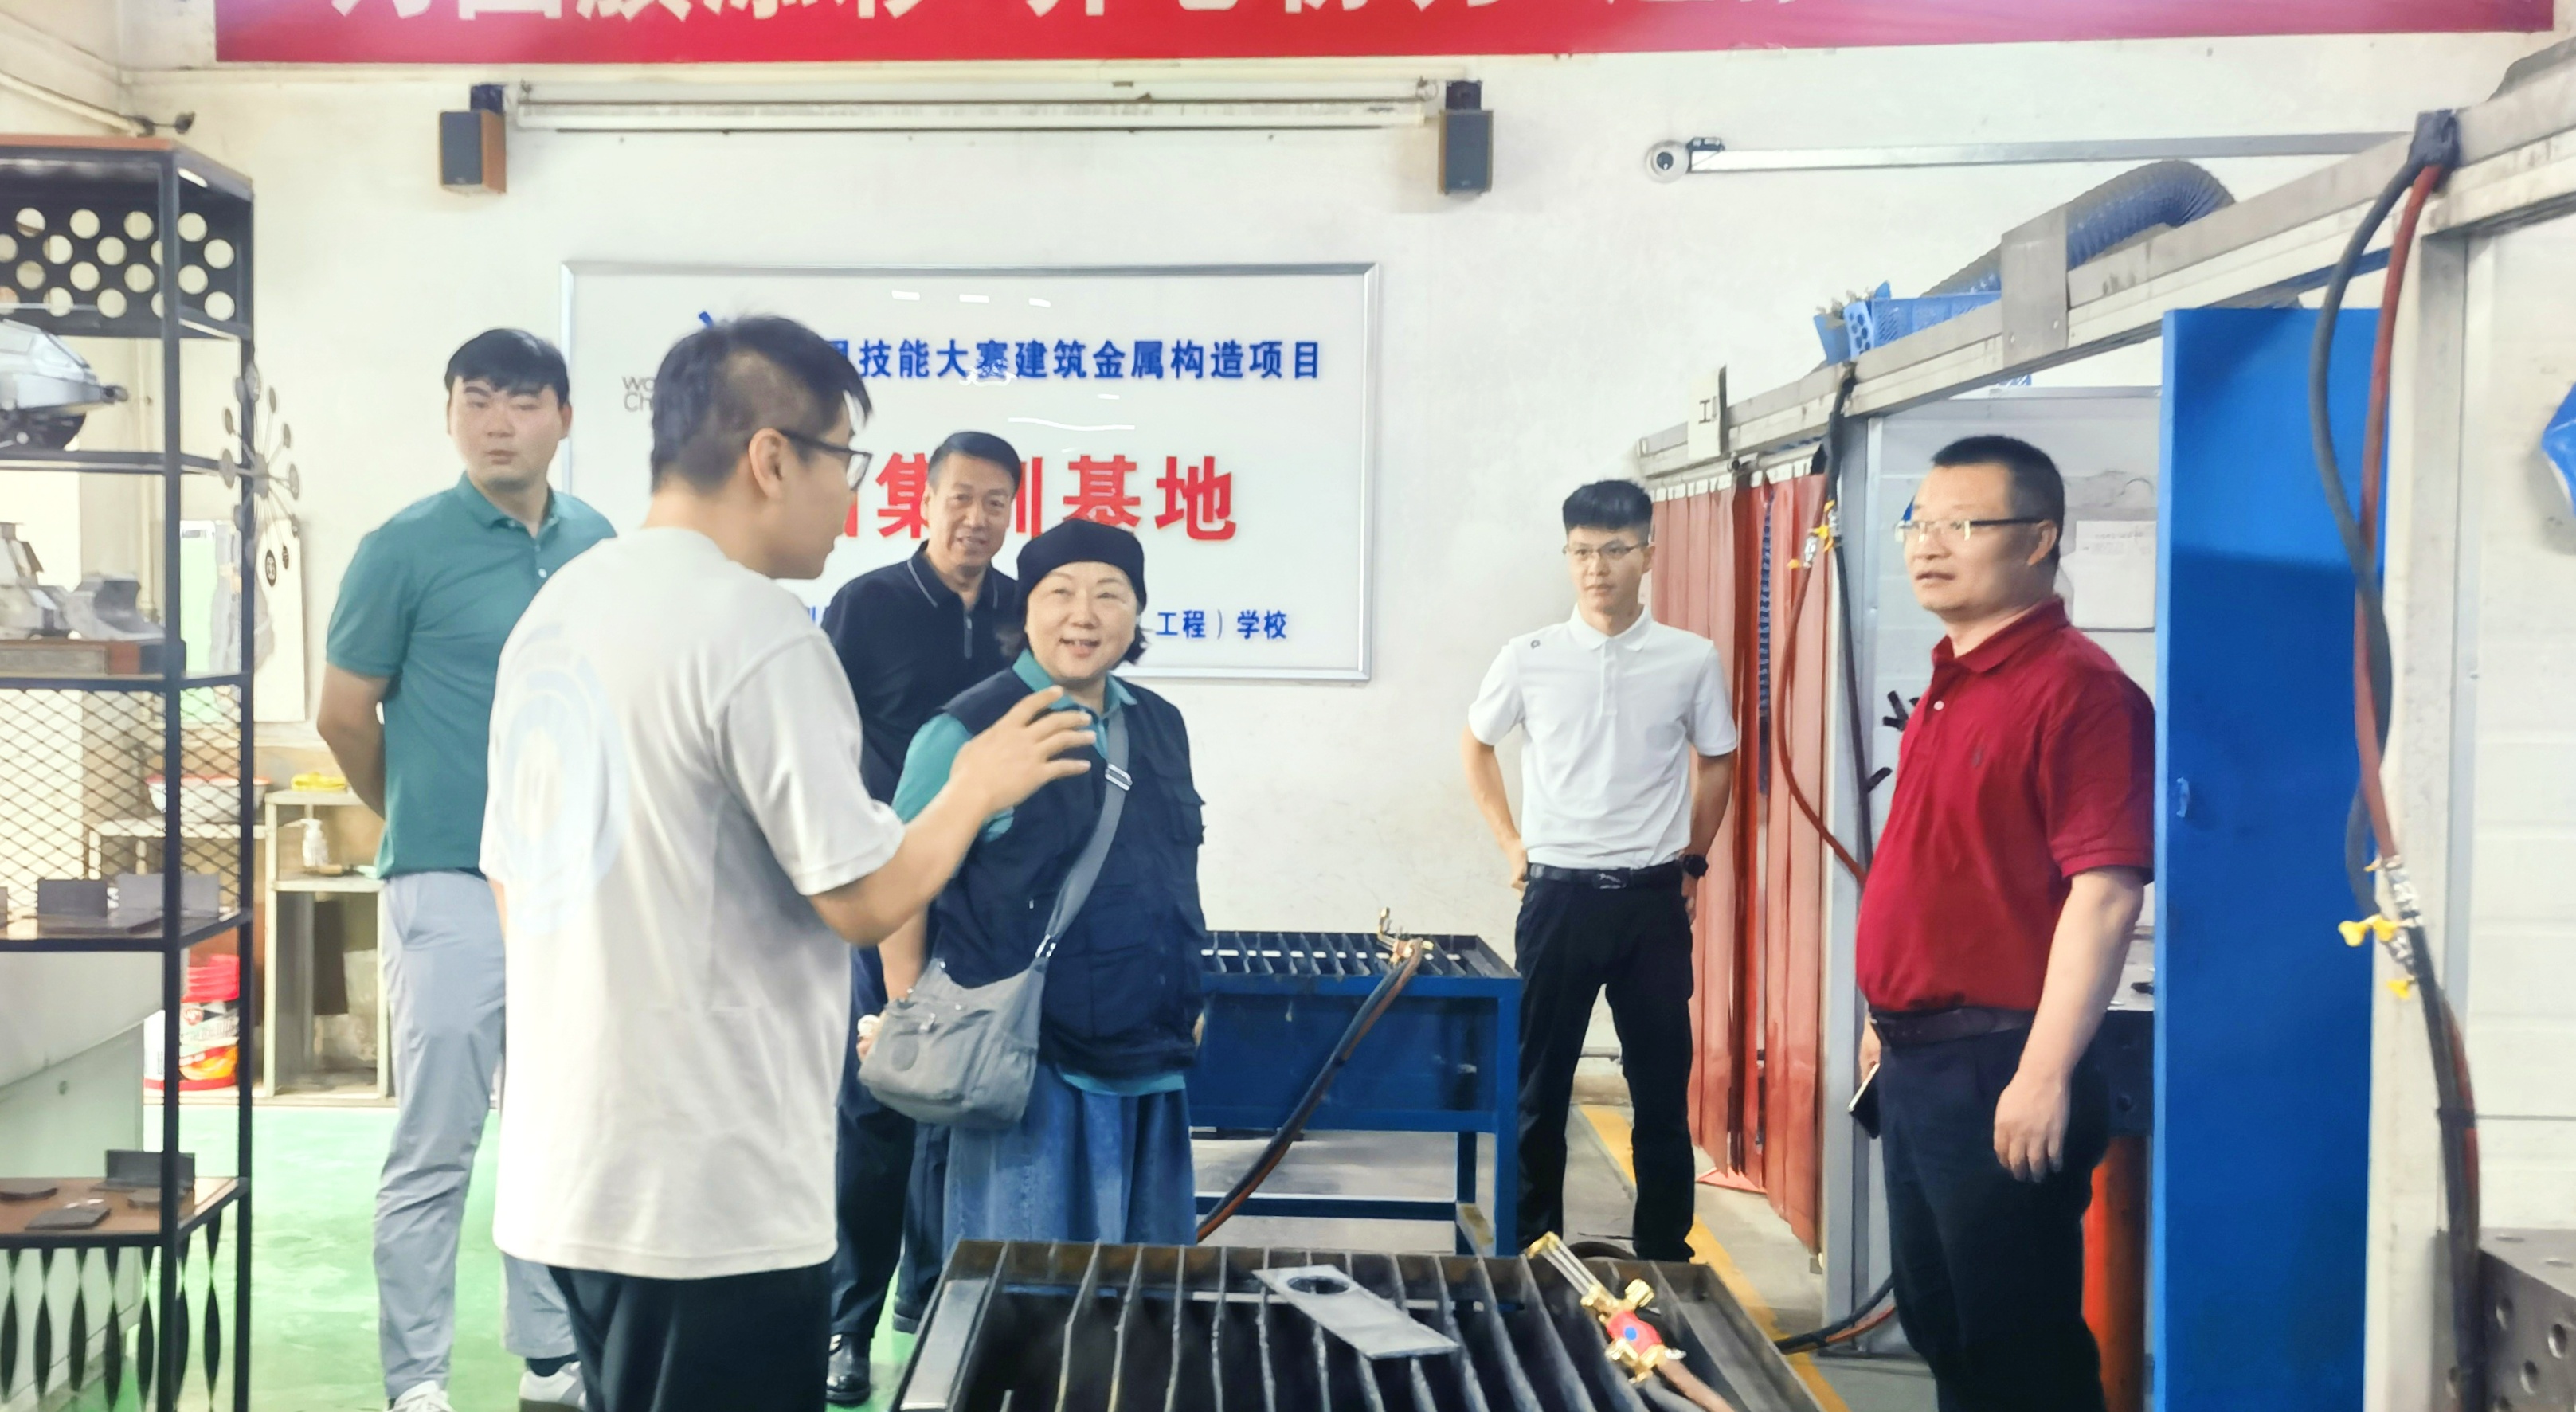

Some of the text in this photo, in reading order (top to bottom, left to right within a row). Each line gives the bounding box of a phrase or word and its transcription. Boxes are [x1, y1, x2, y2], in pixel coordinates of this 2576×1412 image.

[828, 338, 1319, 380] 技能大赛建筑金属构造项目
